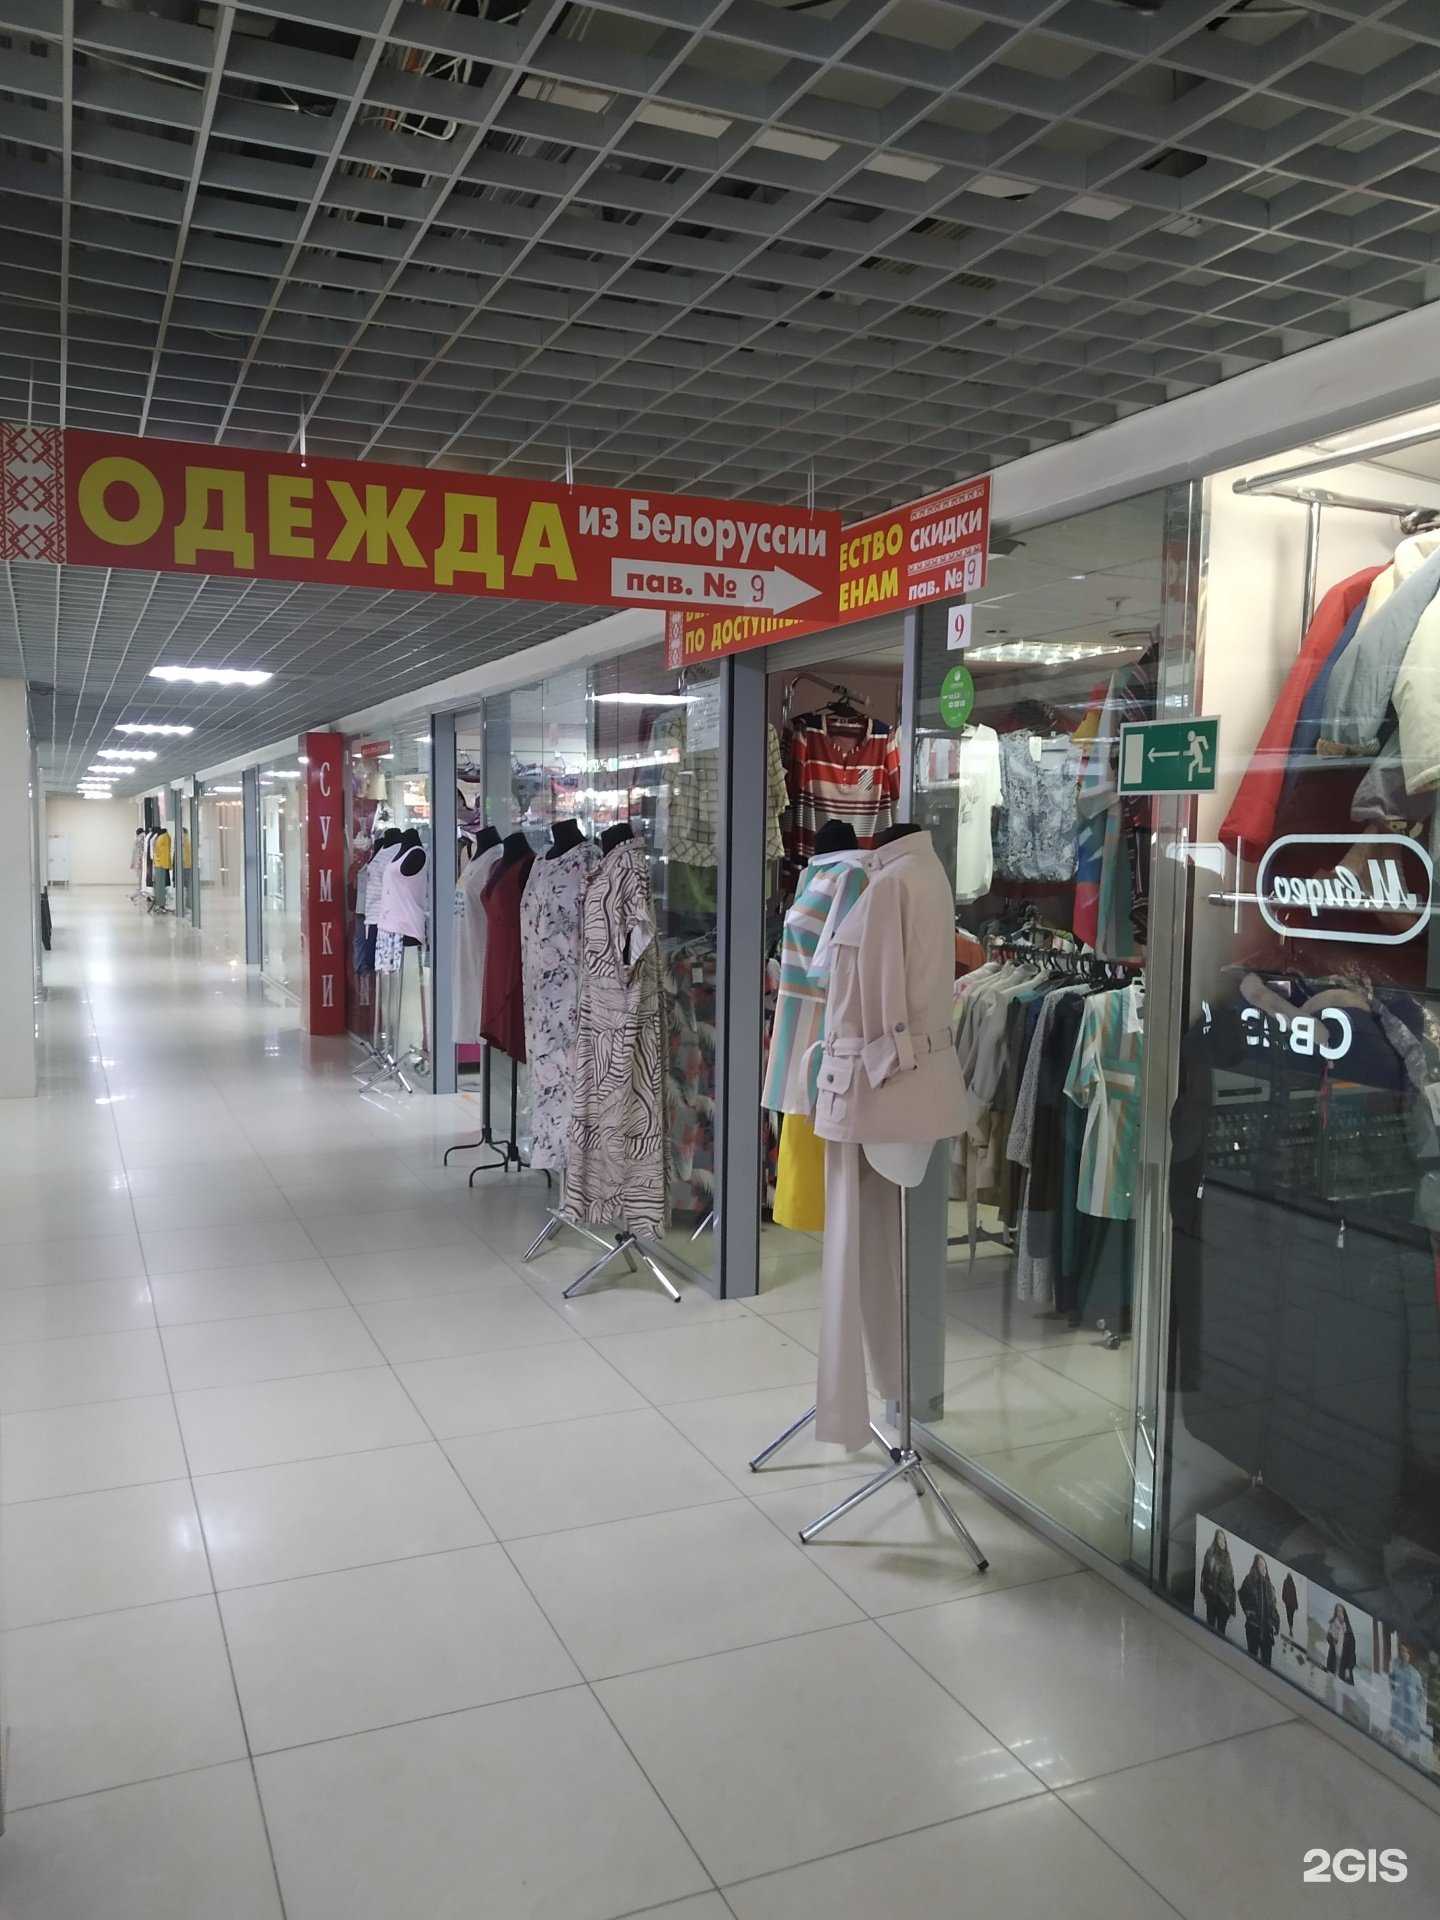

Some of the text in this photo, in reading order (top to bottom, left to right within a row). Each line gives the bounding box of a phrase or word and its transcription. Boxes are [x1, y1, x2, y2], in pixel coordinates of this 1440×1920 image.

[78, 457, 578, 590] ОДЕЖДА
[578, 498, 828, 564] из Белоруссии
[910, 507, 983, 553] СКИДКИ
[839, 523, 904, 572] ЕСТВО
[626, 572, 765, 602] пав. № 9
[839, 567, 899, 611] ЕНАМ
[908, 580, 940, 601] пав.
[967, 558, 977, 586] 9
[685, 627, 705, 655] ПО
[954, 613, 965, 642] 9
[319, 761, 335, 1008] СУМКИ
